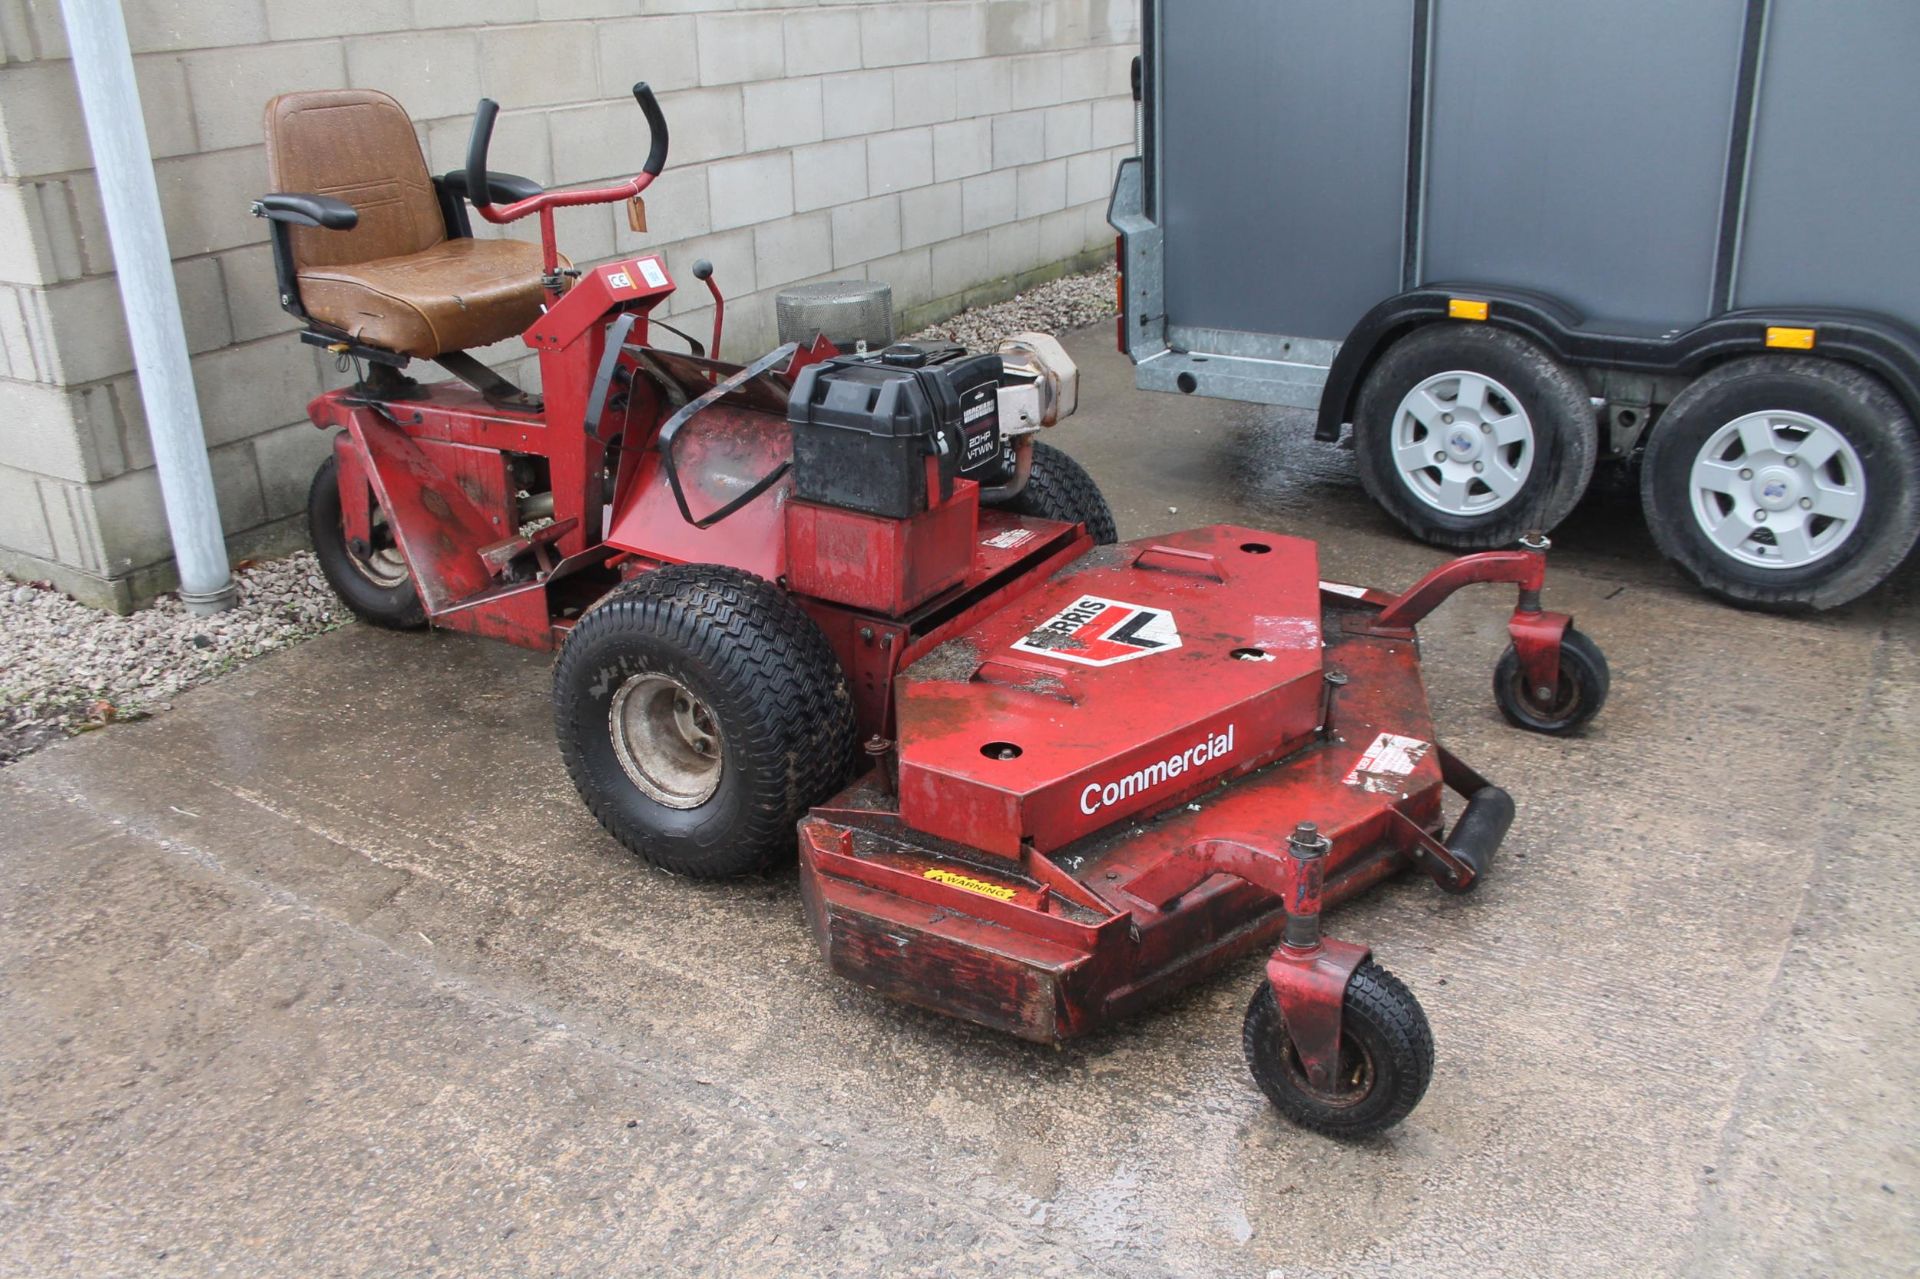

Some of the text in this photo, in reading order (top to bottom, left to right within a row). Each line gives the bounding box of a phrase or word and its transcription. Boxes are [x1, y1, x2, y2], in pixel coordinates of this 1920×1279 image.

[967, 440, 994, 460] V-TWIN
[1024, 600, 1107, 649] RRIS
[1080, 724, 1234, 815] Commercial
[947, 876, 1006, 897] WARNING
